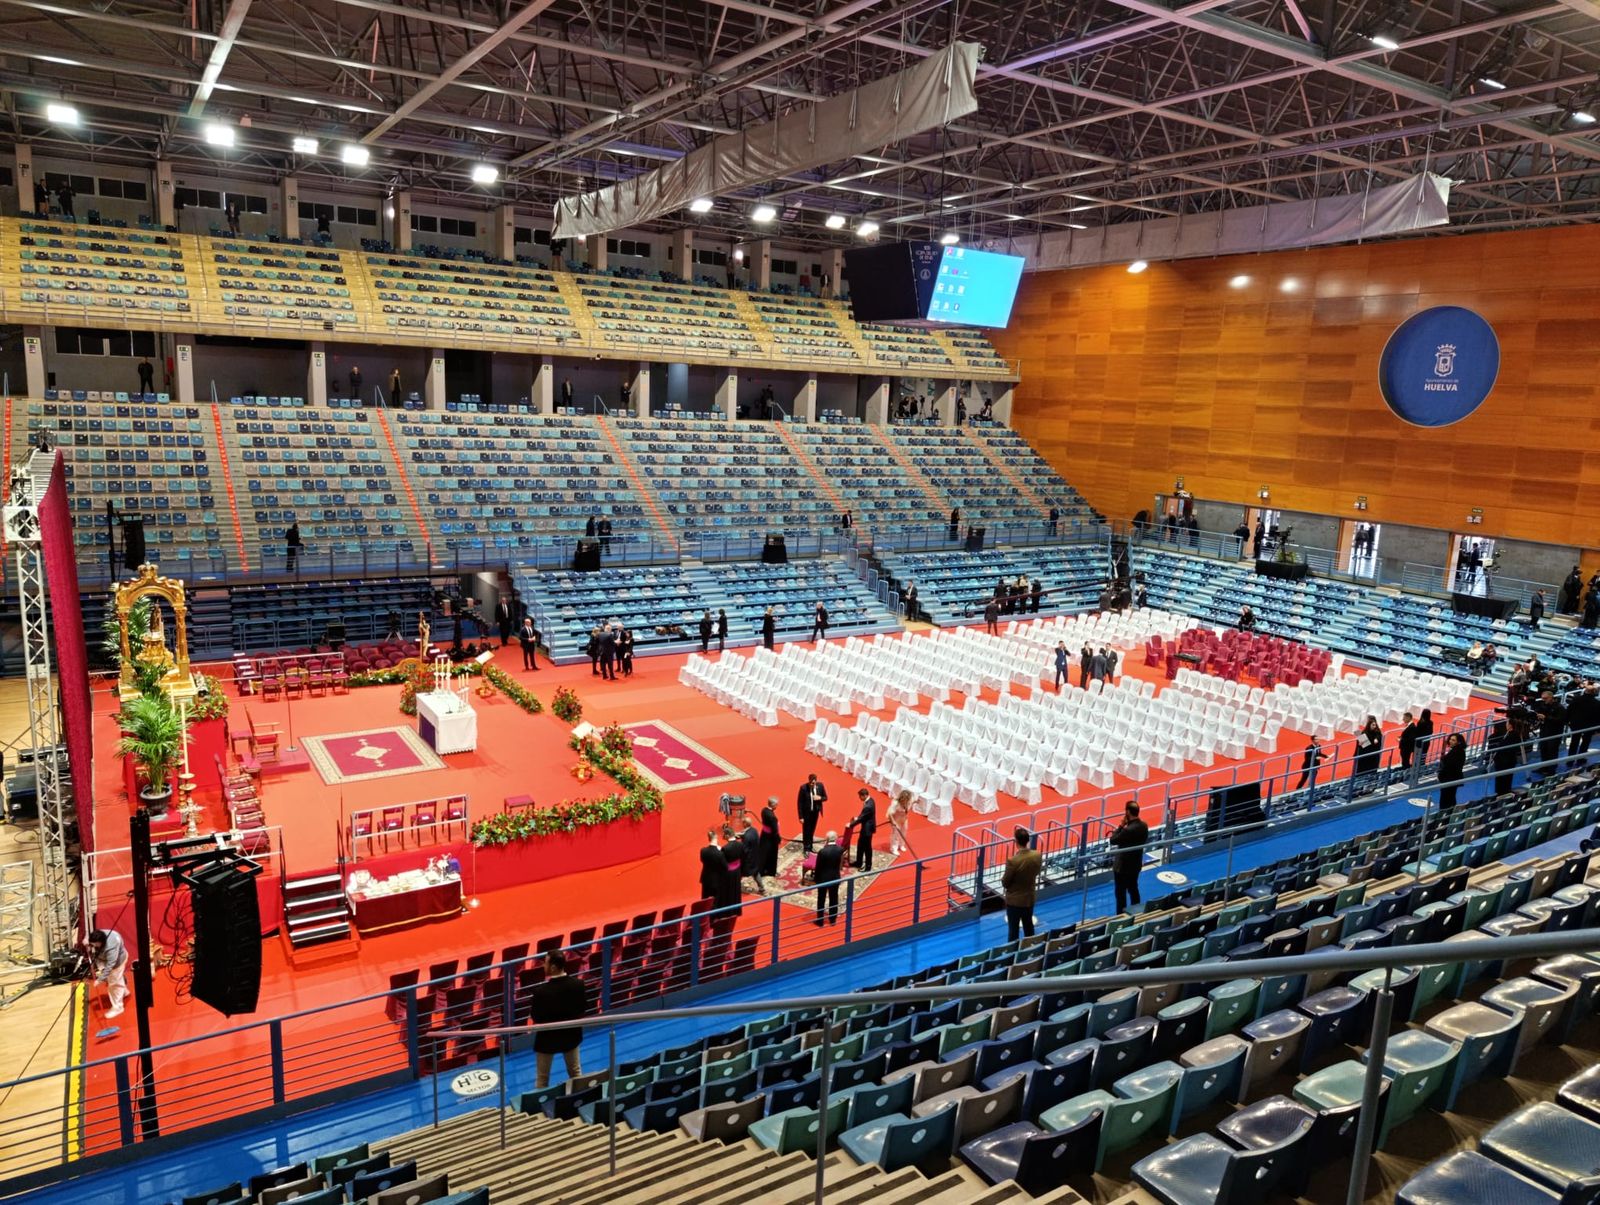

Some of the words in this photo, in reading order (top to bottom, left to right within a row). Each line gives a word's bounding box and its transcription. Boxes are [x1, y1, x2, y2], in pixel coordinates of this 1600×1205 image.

[1424, 383, 1458, 391] HUELVA
[457, 1077, 471, 1088] H
[478, 1072, 491, 1082] G
[466, 1084, 491, 1093] SECTOR
